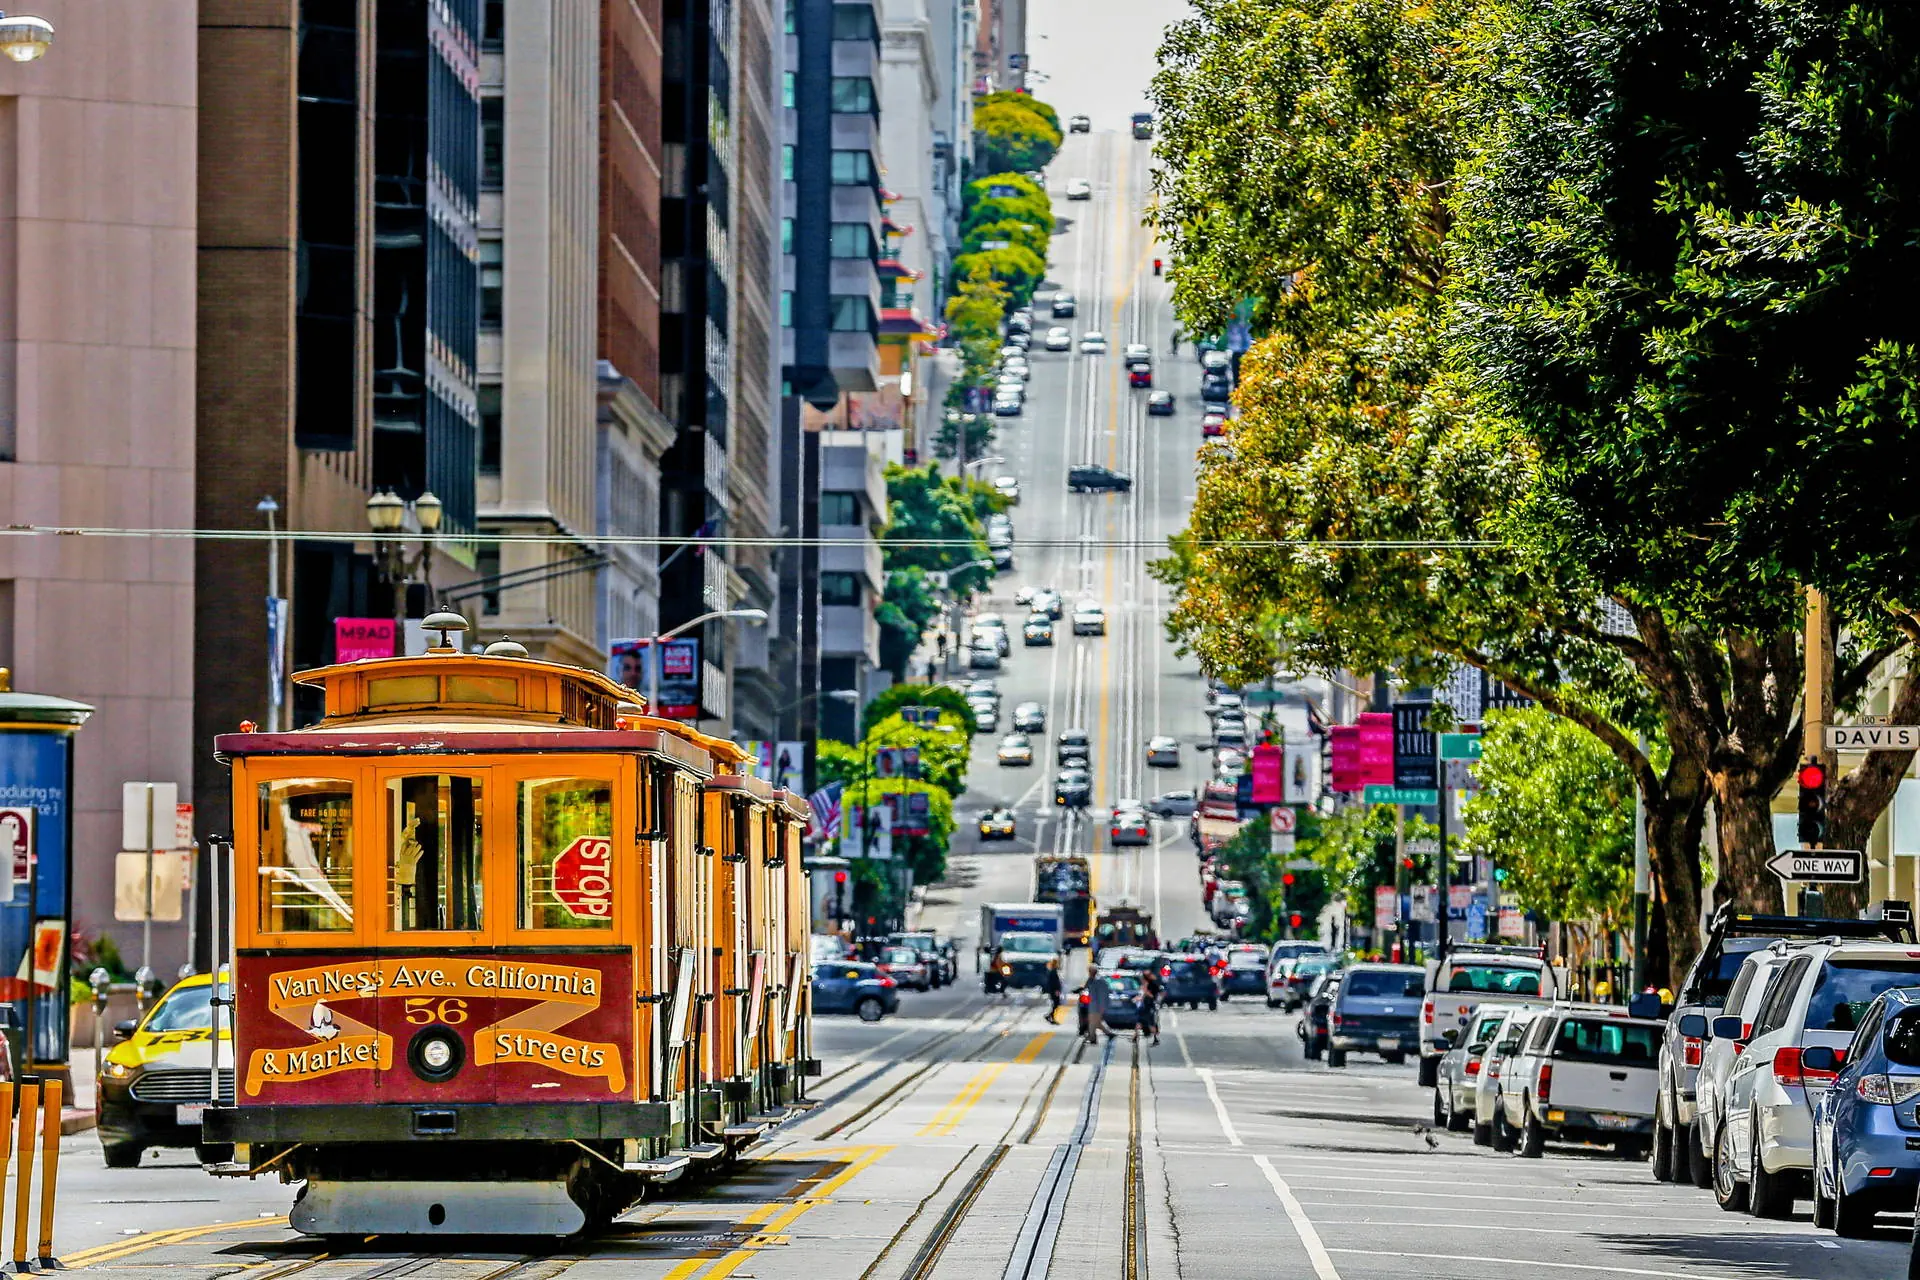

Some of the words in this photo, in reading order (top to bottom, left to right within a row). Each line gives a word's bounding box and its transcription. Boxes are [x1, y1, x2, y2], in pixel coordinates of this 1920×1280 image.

[1861, 714, 1875, 725] 100
[1835, 729, 1910, 745] DAVIS
[1372, 790, 1429, 801] Battery
[578, 840, 611, 915] STOP
[1793, 859, 1819, 872] ONE
[1823, 859, 1851, 872] WAY
[275, 976, 320, 1000] Van
[322, 969, 385, 994] Ness
[466, 965, 597, 996] California
[405, 997, 469, 1025] 56
[262, 1051, 282, 1075] &
[285, 1038, 381, 1075] Market
[496, 1033, 607, 1068] Streets
